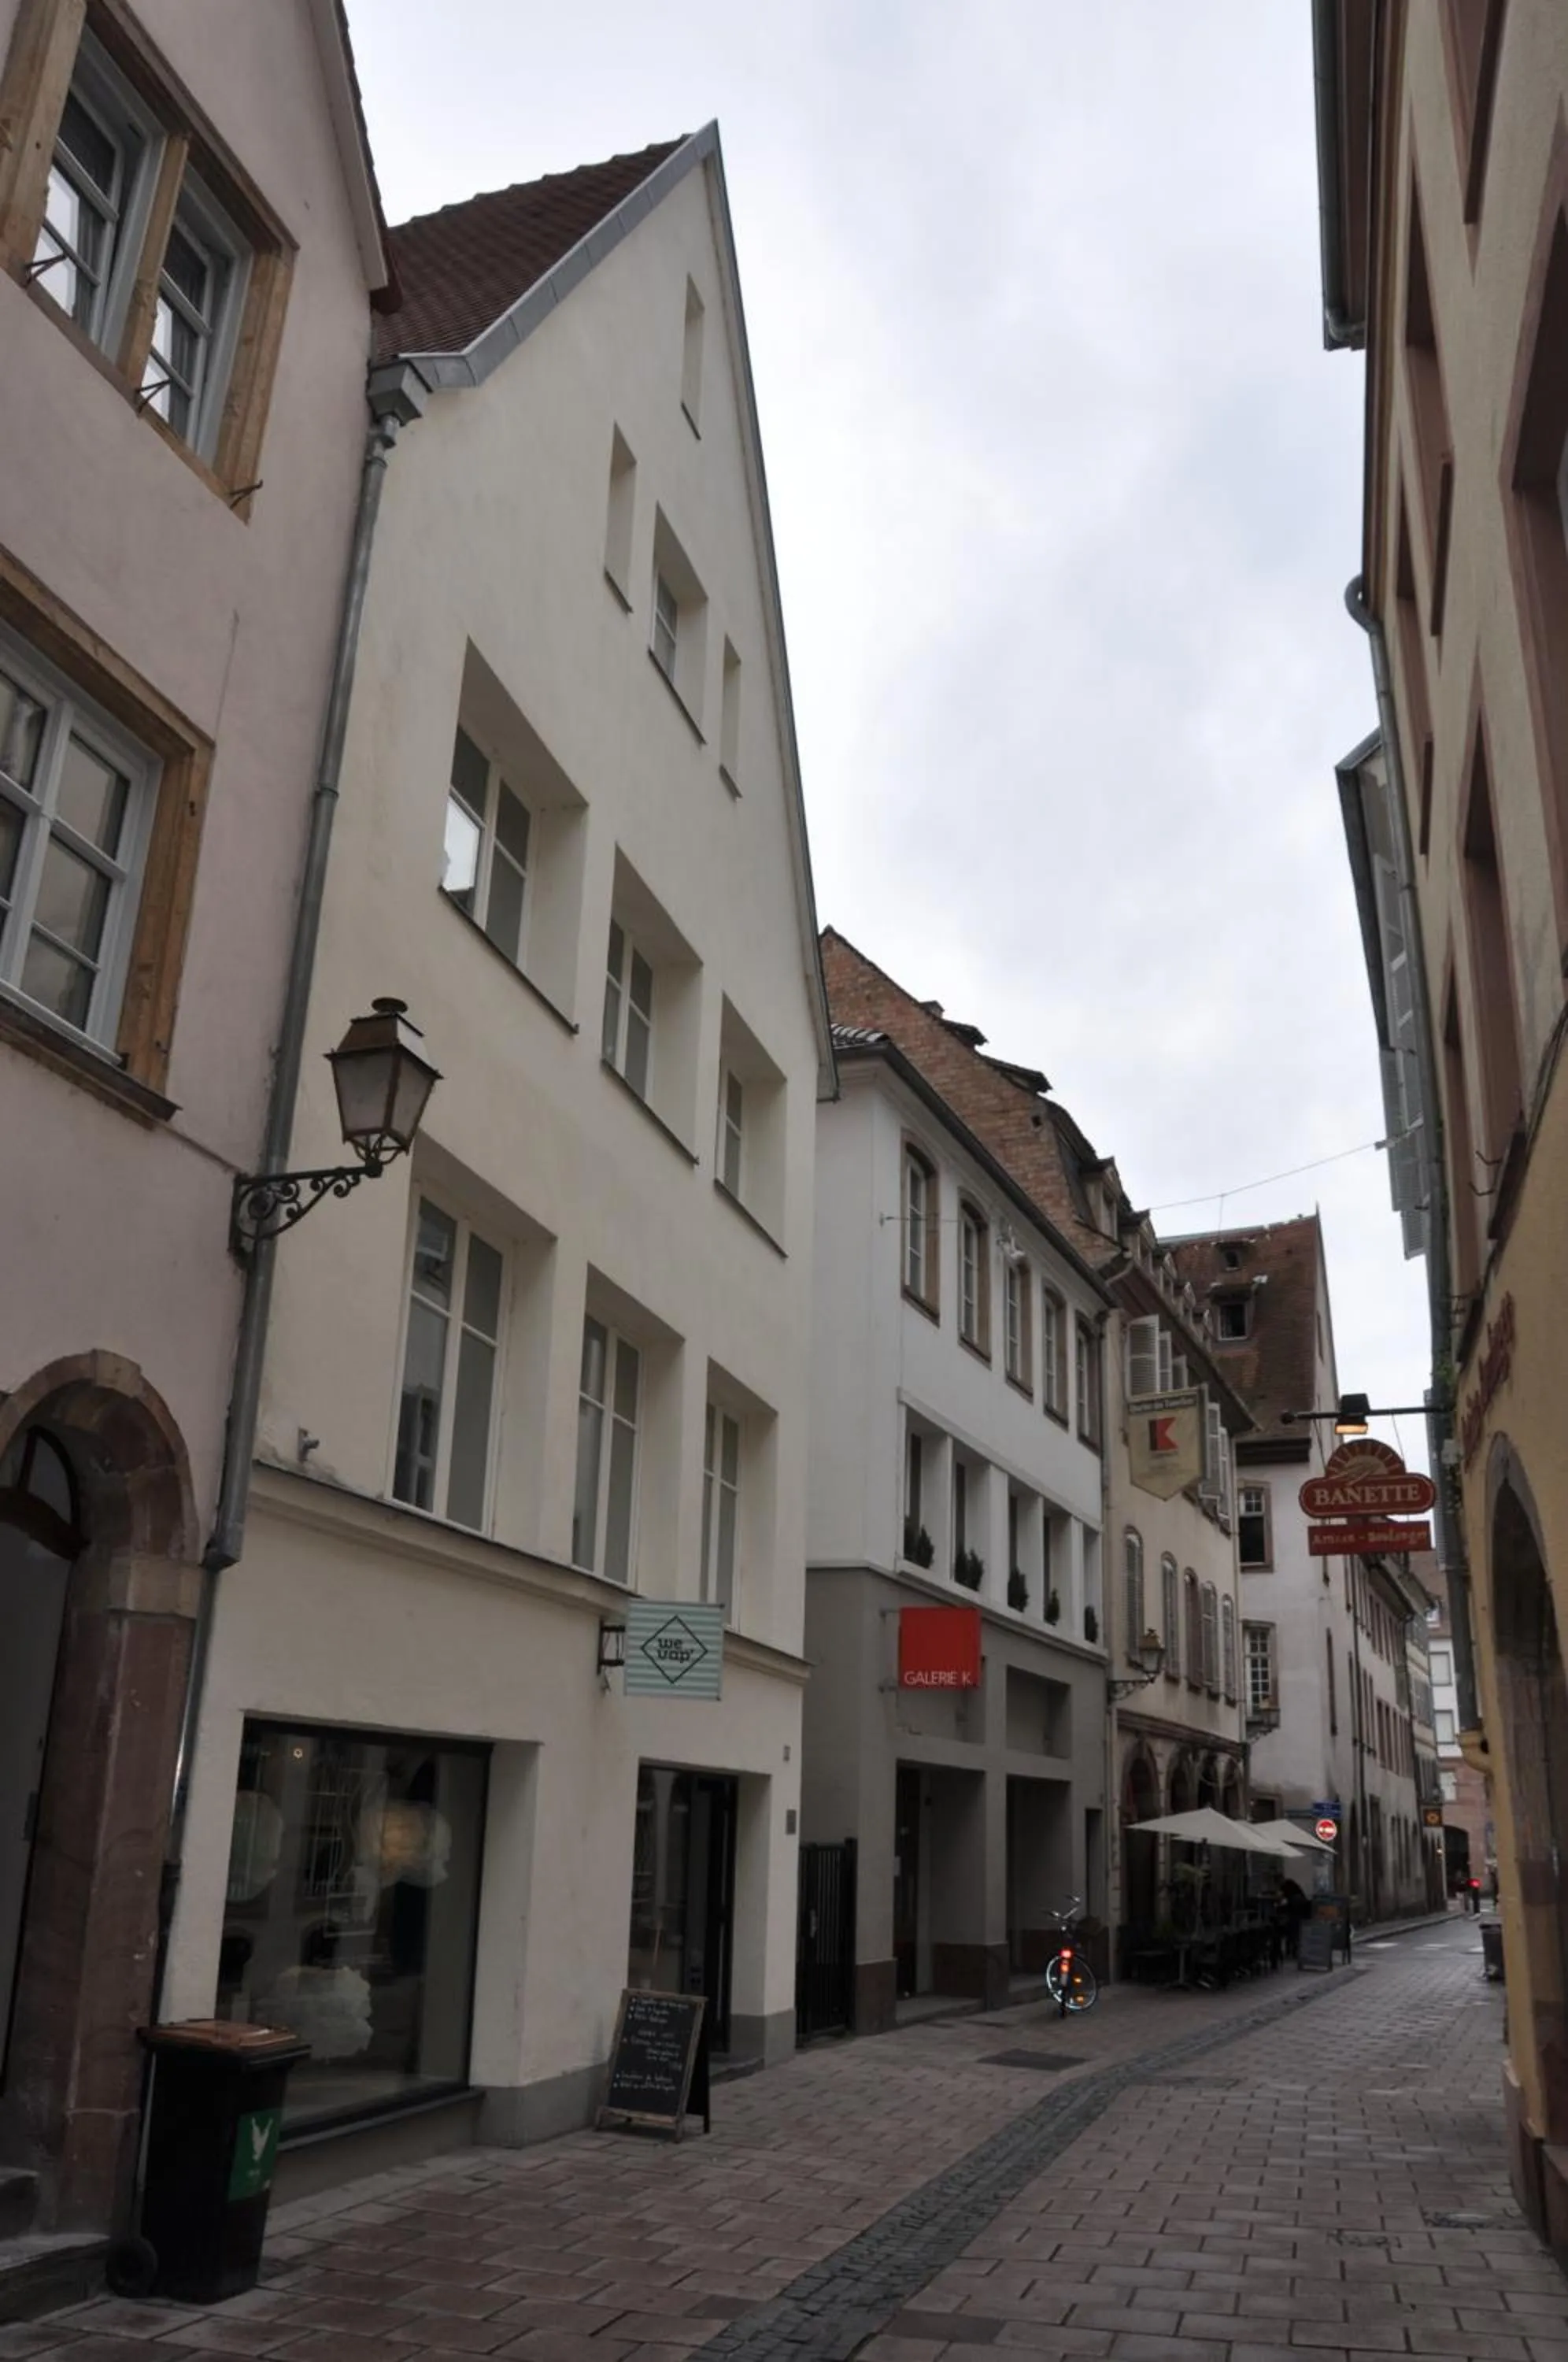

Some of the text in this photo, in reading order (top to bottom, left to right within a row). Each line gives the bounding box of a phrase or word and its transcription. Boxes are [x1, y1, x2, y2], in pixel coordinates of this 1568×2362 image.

[1314, 1484, 1420, 1506] BANETTE
[658, 1638, 683, 1649] we
[904, 1671, 971, 1685] GALERIE K
